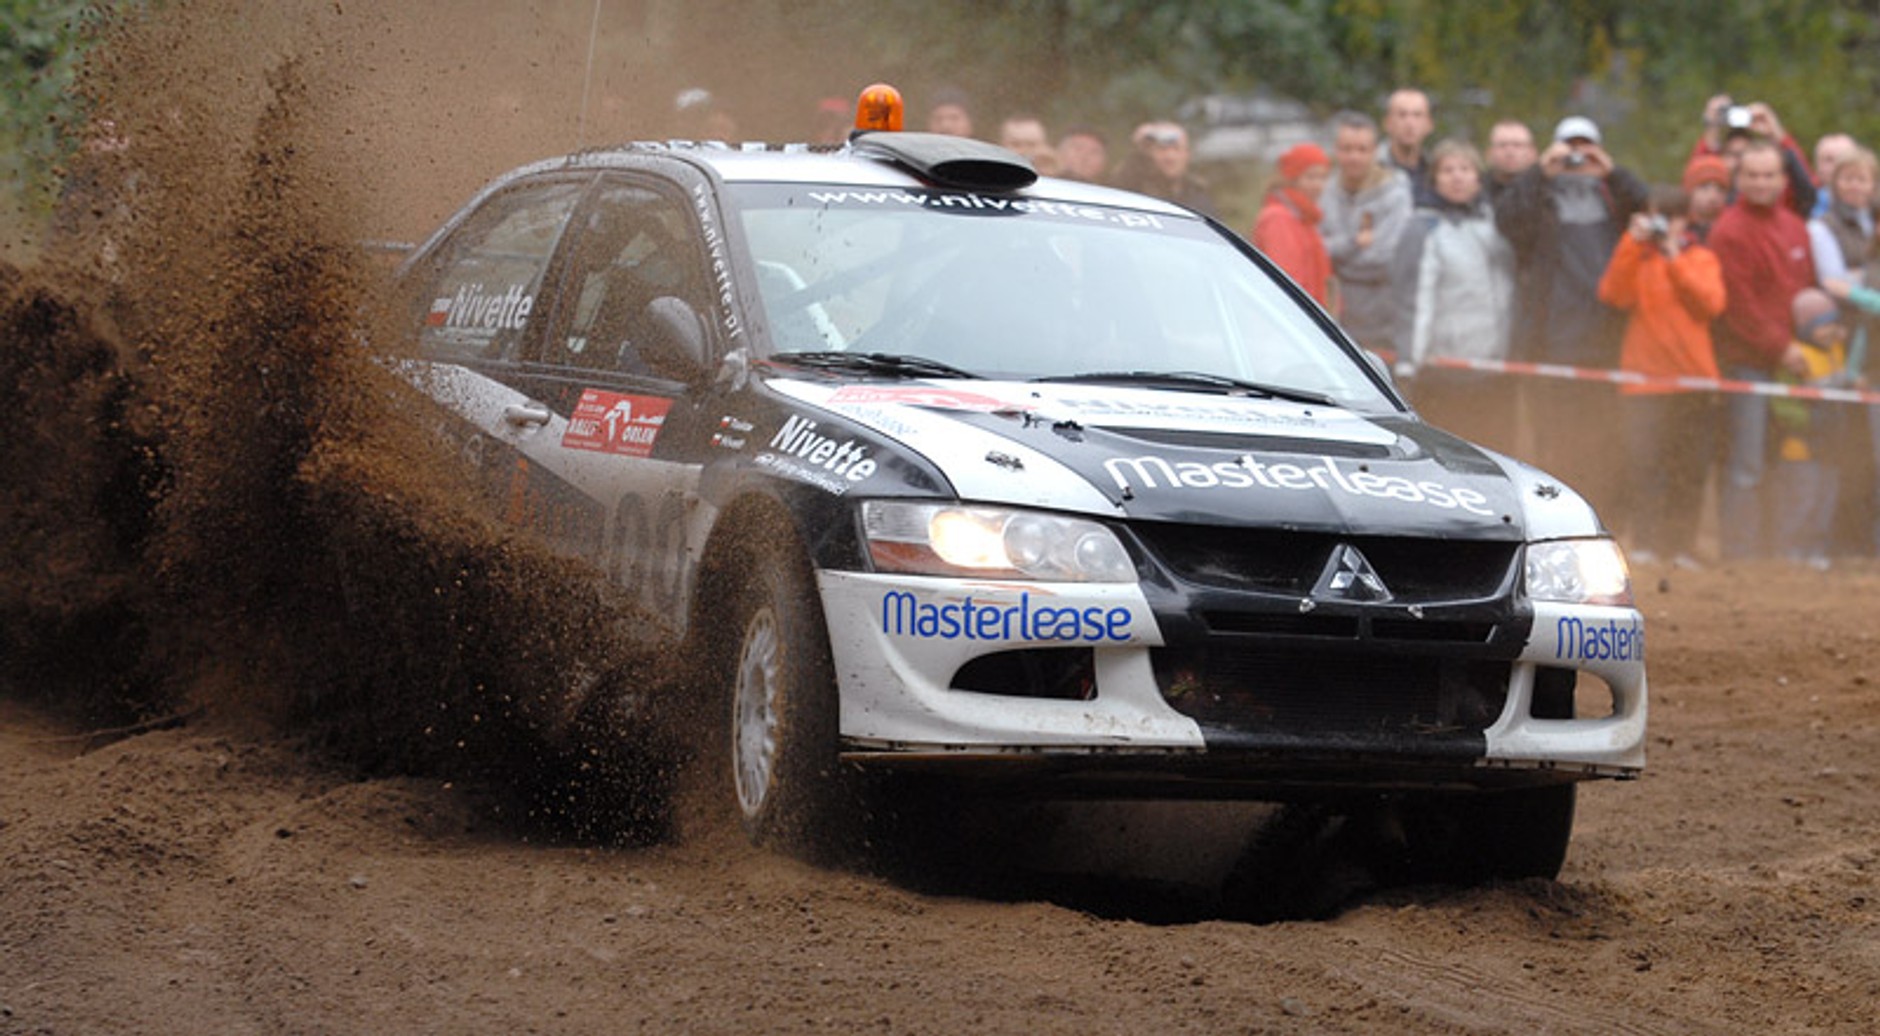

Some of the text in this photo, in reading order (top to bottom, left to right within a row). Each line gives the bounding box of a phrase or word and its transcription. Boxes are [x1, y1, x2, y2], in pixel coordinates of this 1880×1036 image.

[809, 191, 1164, 230] www.nivette.pl
[694, 183, 743, 338] www.nivette.pl
[446, 283, 533, 330] Nivette
[622, 425, 658, 445] ORLEN
[769, 413, 878, 483] Nivette
[1104, 455, 1495, 516] Masterlease
[882, 590, 1132, 641] Masterlease
